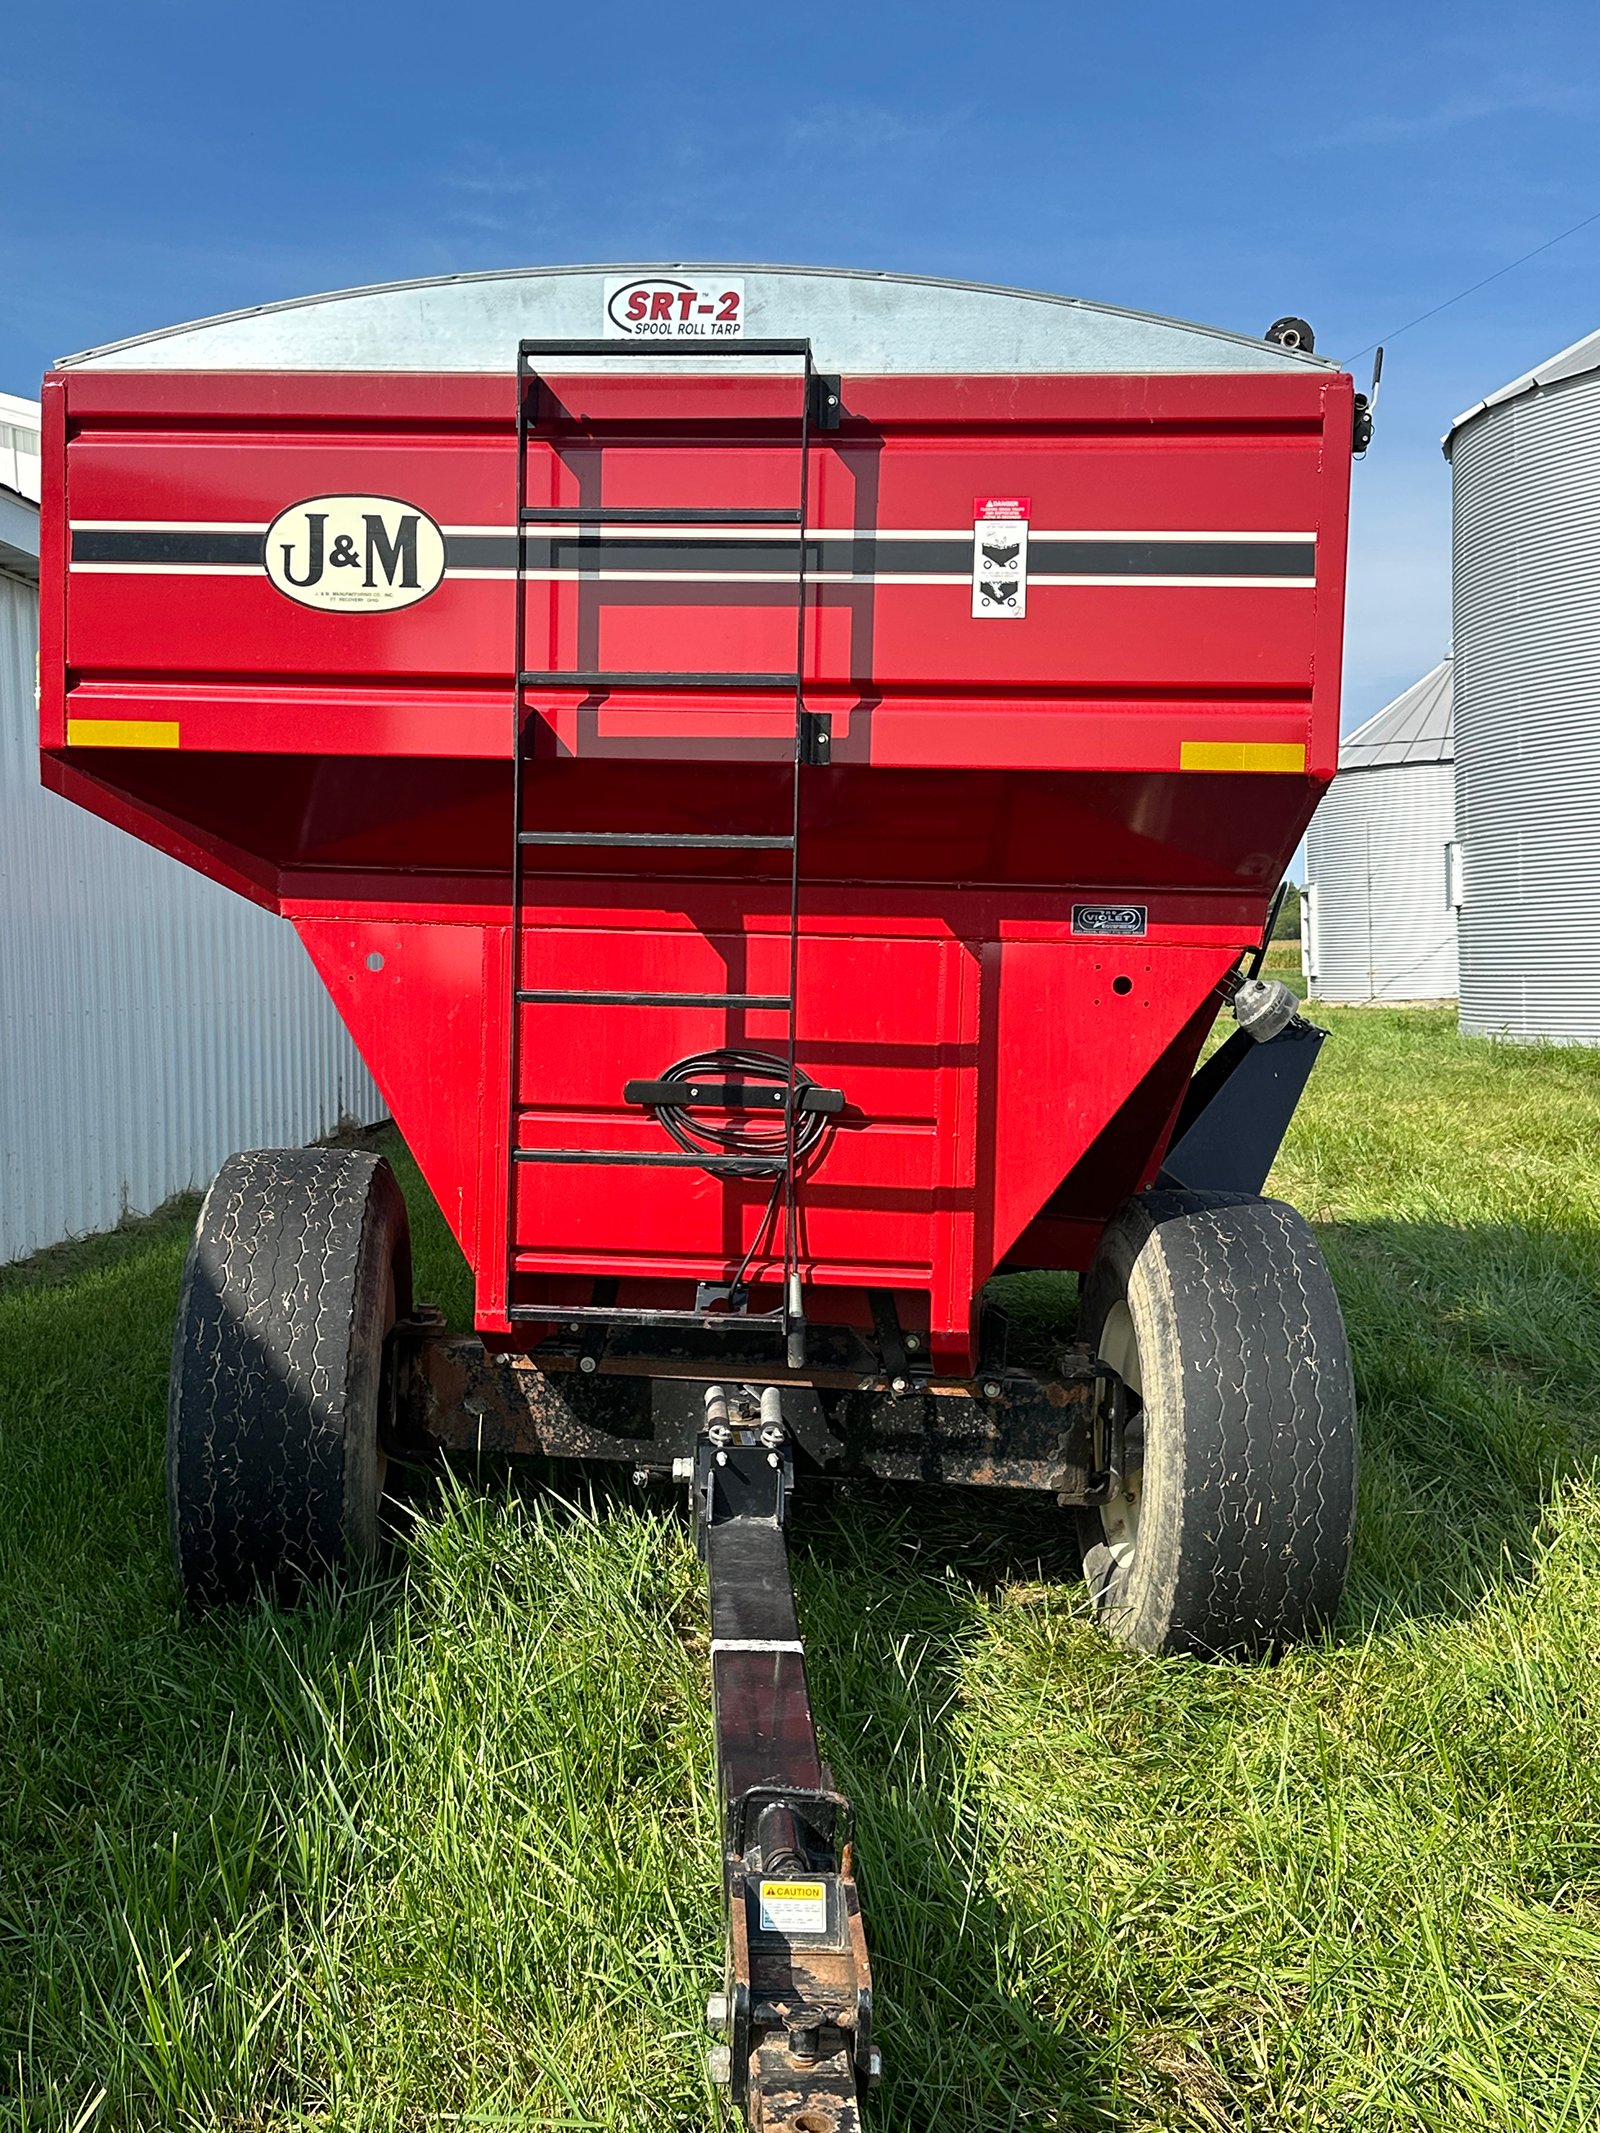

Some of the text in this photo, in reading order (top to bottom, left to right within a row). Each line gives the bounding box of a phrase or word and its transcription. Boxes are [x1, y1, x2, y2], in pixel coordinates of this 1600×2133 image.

[625, 290, 740, 321] SRT-2
[635, 322, 741, 335] SPOOL ROLL TARP
[1086, 914, 1131, 922] VIOLET
[776, 1887, 820, 1897] CAUTION
